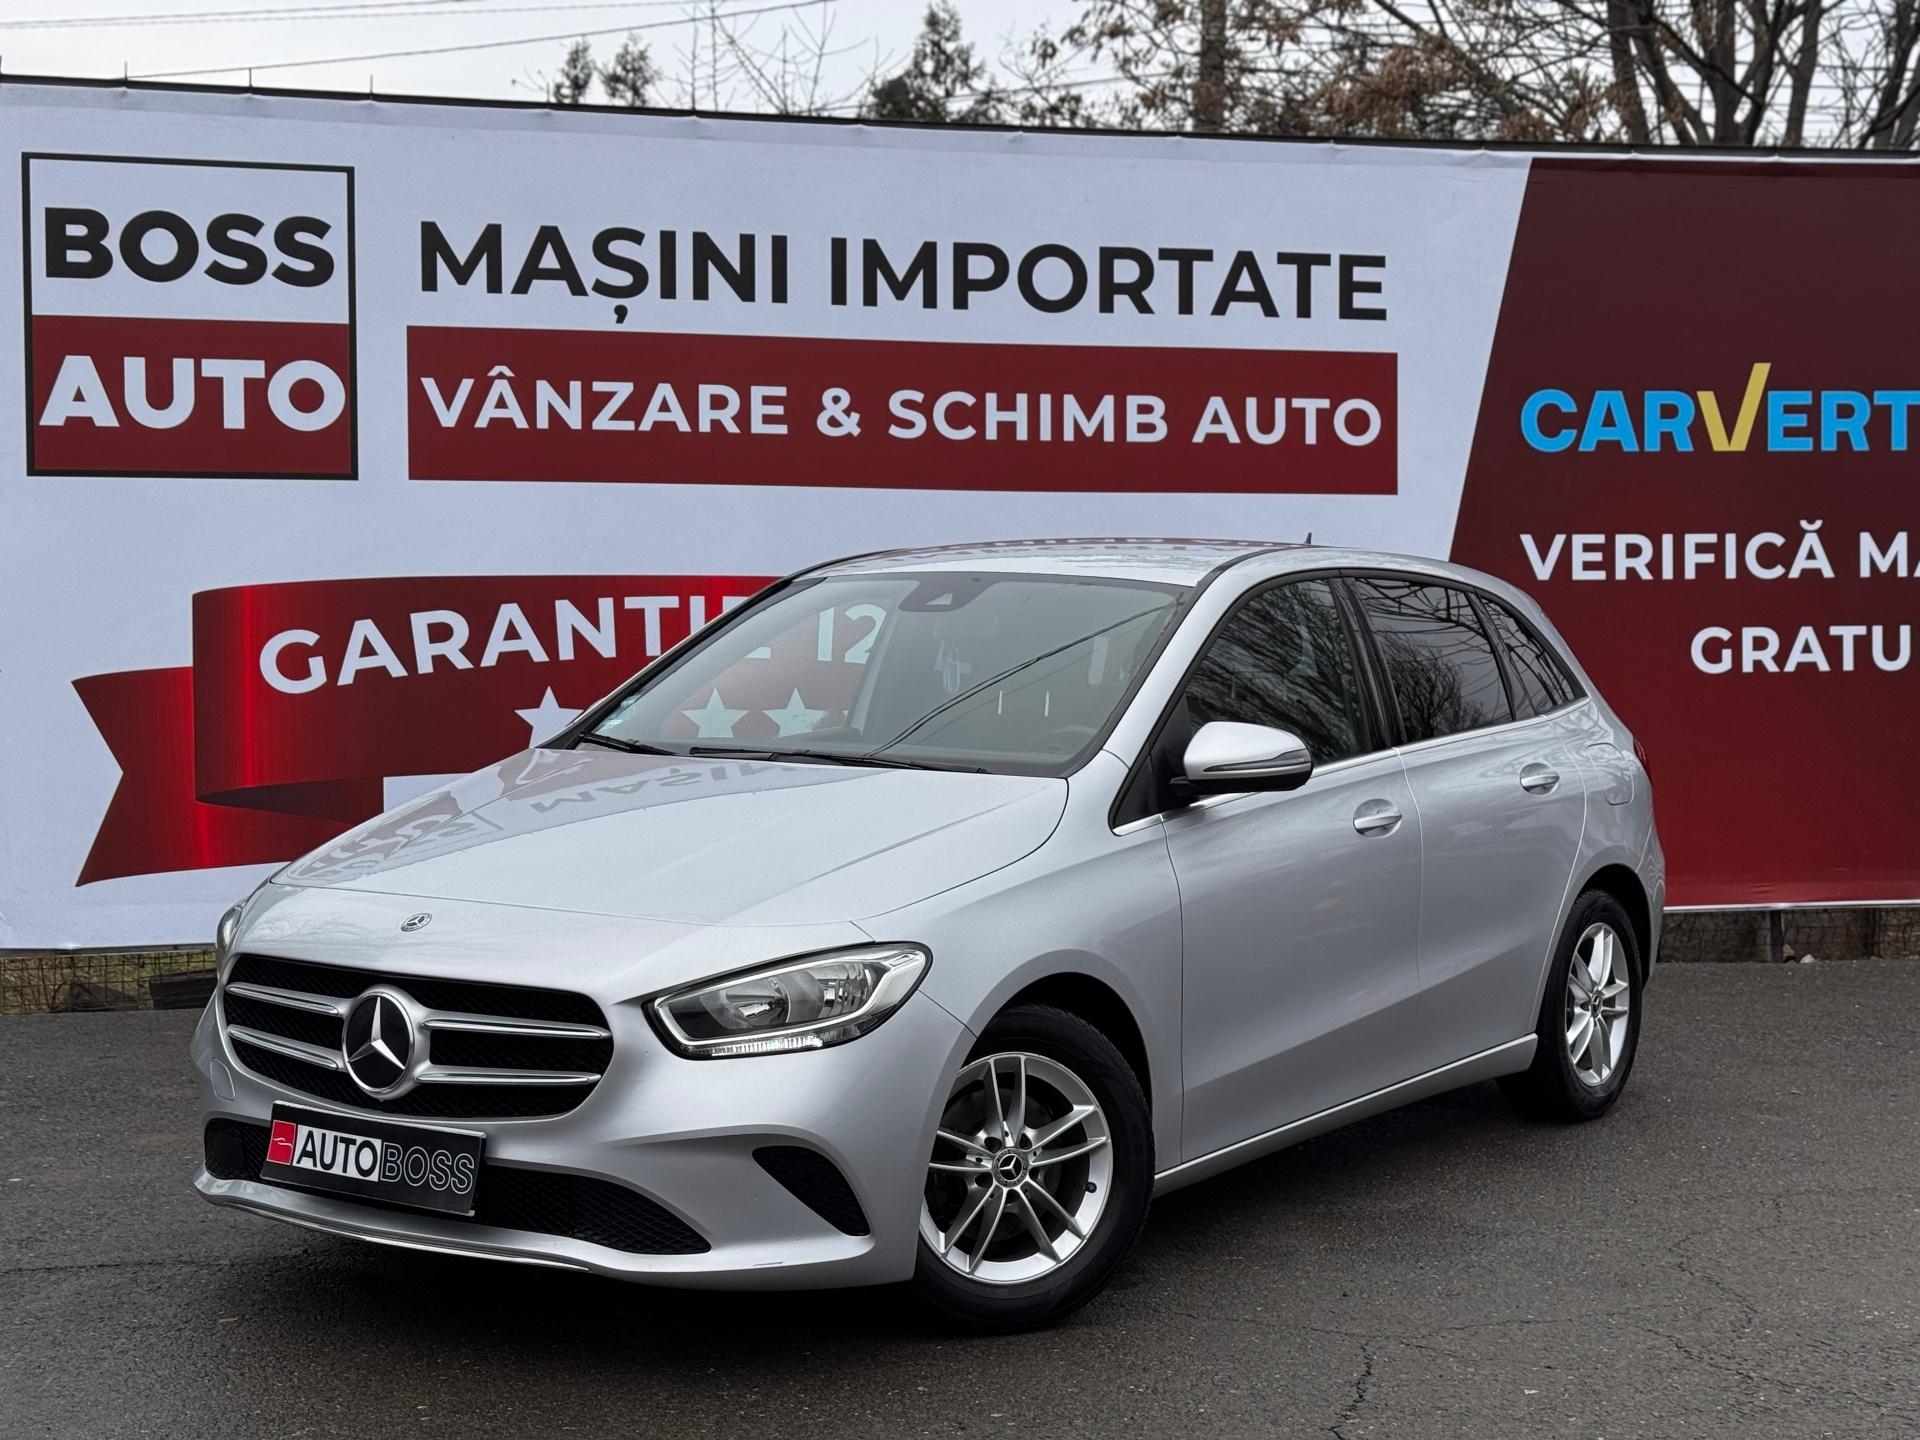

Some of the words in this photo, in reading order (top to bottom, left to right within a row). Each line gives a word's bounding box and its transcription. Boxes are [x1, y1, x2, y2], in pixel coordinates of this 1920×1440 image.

[44, 206, 334, 287] BOSS
[421, 220, 788, 324] MAȘINI
[830, 236, 1388, 321] IMPORTATE
[39, 355, 346, 431] AUTO
[421, 365, 789, 435] VÂNZARE
[816, 387, 861, 438] &
[888, 390, 1168, 443] SCHIMB
[1192, 396, 1382, 446] AUTO
[1520, 362, 1920, 452] CARVERT
[1519, 519, 1835, 581] VERIFICĂ
[1859, 531, 1920, 578] M
[817, 604, 887, 664] 12
[1691, 624, 1911, 674] GRATU
[297, 1130, 475, 1194] AUTOBOSS
